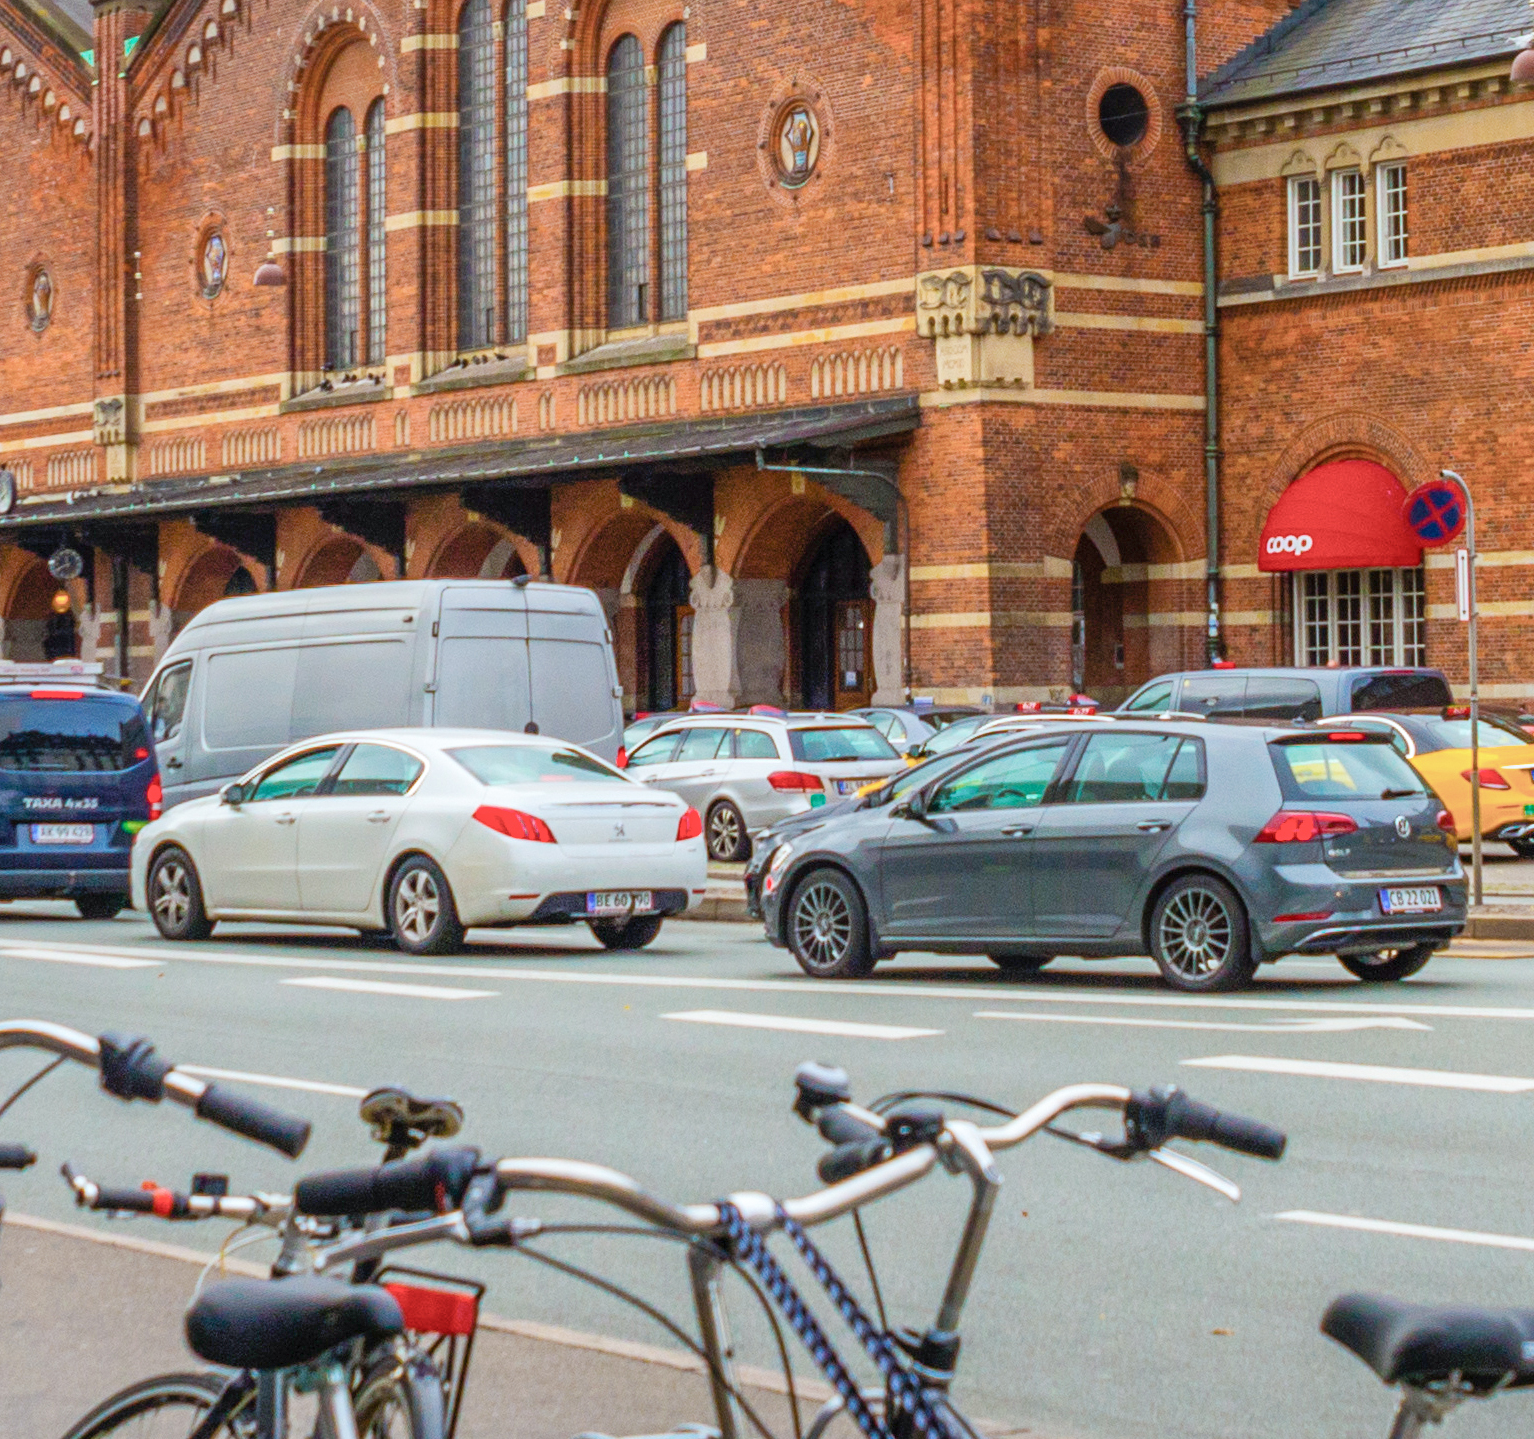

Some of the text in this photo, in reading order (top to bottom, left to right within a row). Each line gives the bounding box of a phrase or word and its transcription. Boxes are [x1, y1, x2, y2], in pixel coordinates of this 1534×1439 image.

[1266, 535, 1313, 556] coop
[22, 797, 63, 809] TAXA
[596, 893, 612, 907] BE
[614, 892, 628, 906] 60
[1389, 889, 1439, 907] CB 22 021
